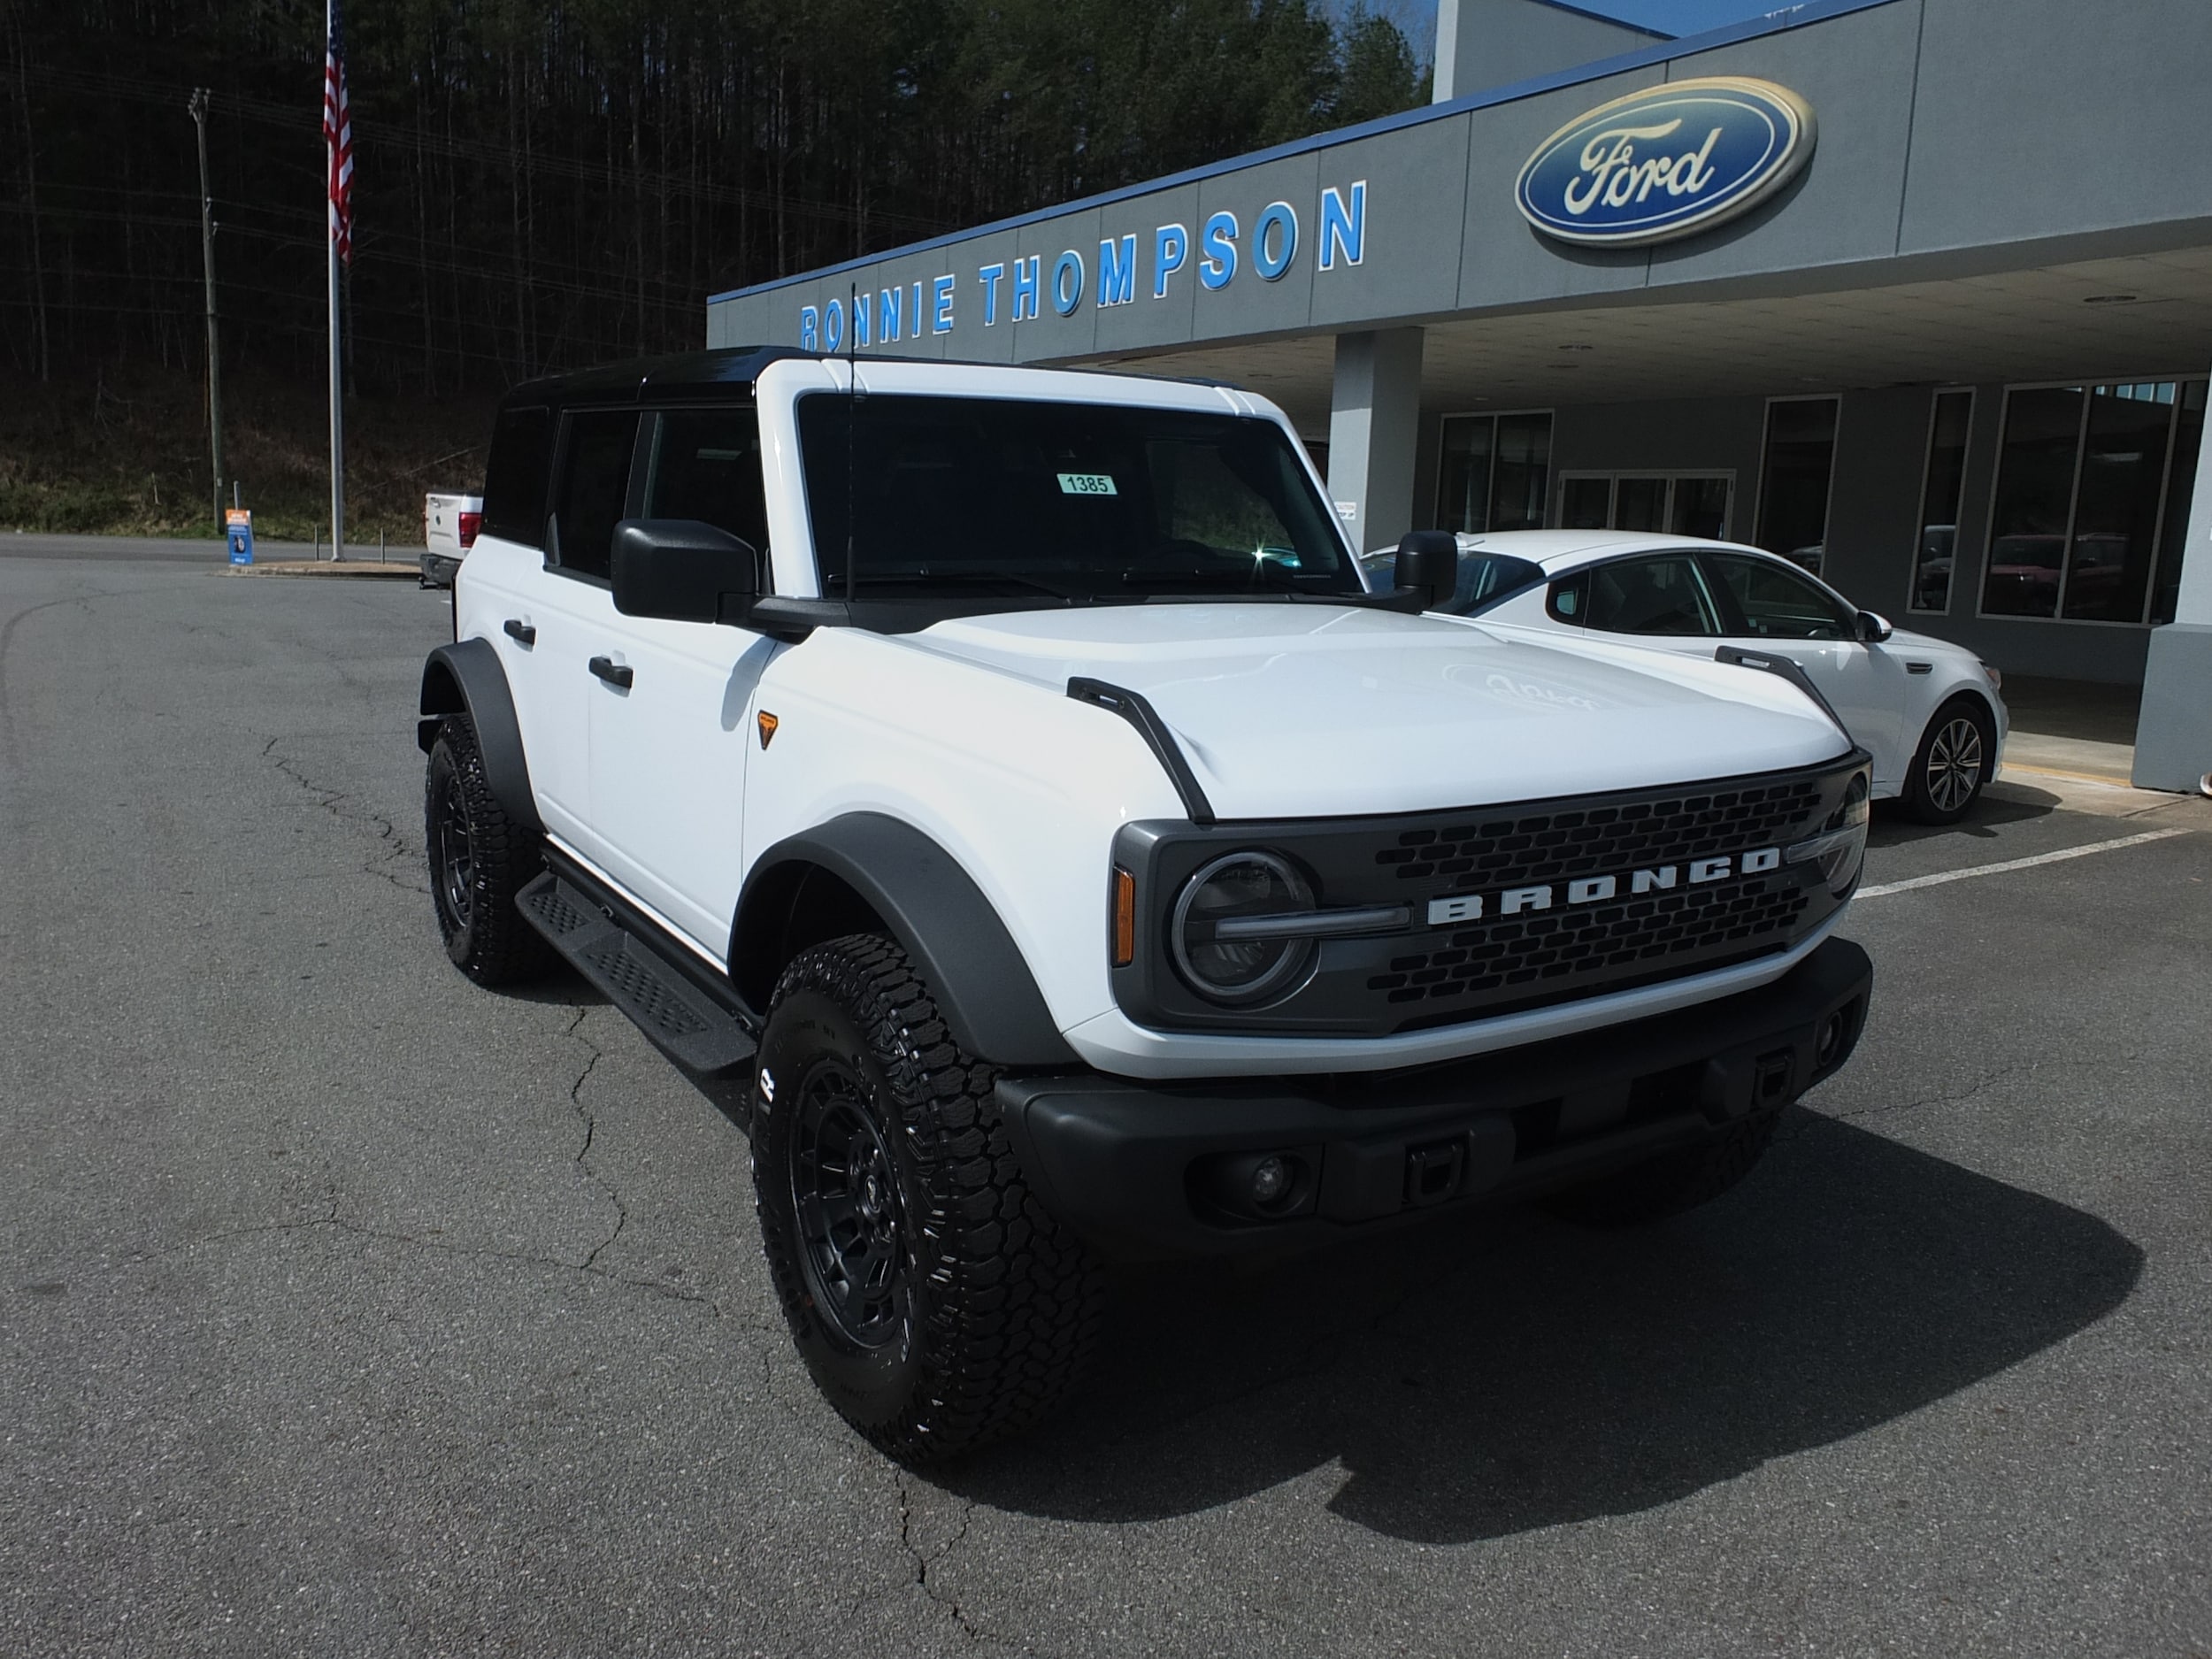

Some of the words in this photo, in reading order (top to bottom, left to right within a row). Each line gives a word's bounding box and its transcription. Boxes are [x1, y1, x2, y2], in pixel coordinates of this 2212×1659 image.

[1563, 119, 1723, 214] Ford
[801, 273, 956, 353] RONNIE
[978, 180, 1368, 326] THOMPSON
[1067, 476, 1109, 492] 1385
[1427, 847, 1780, 926] BRONCO
